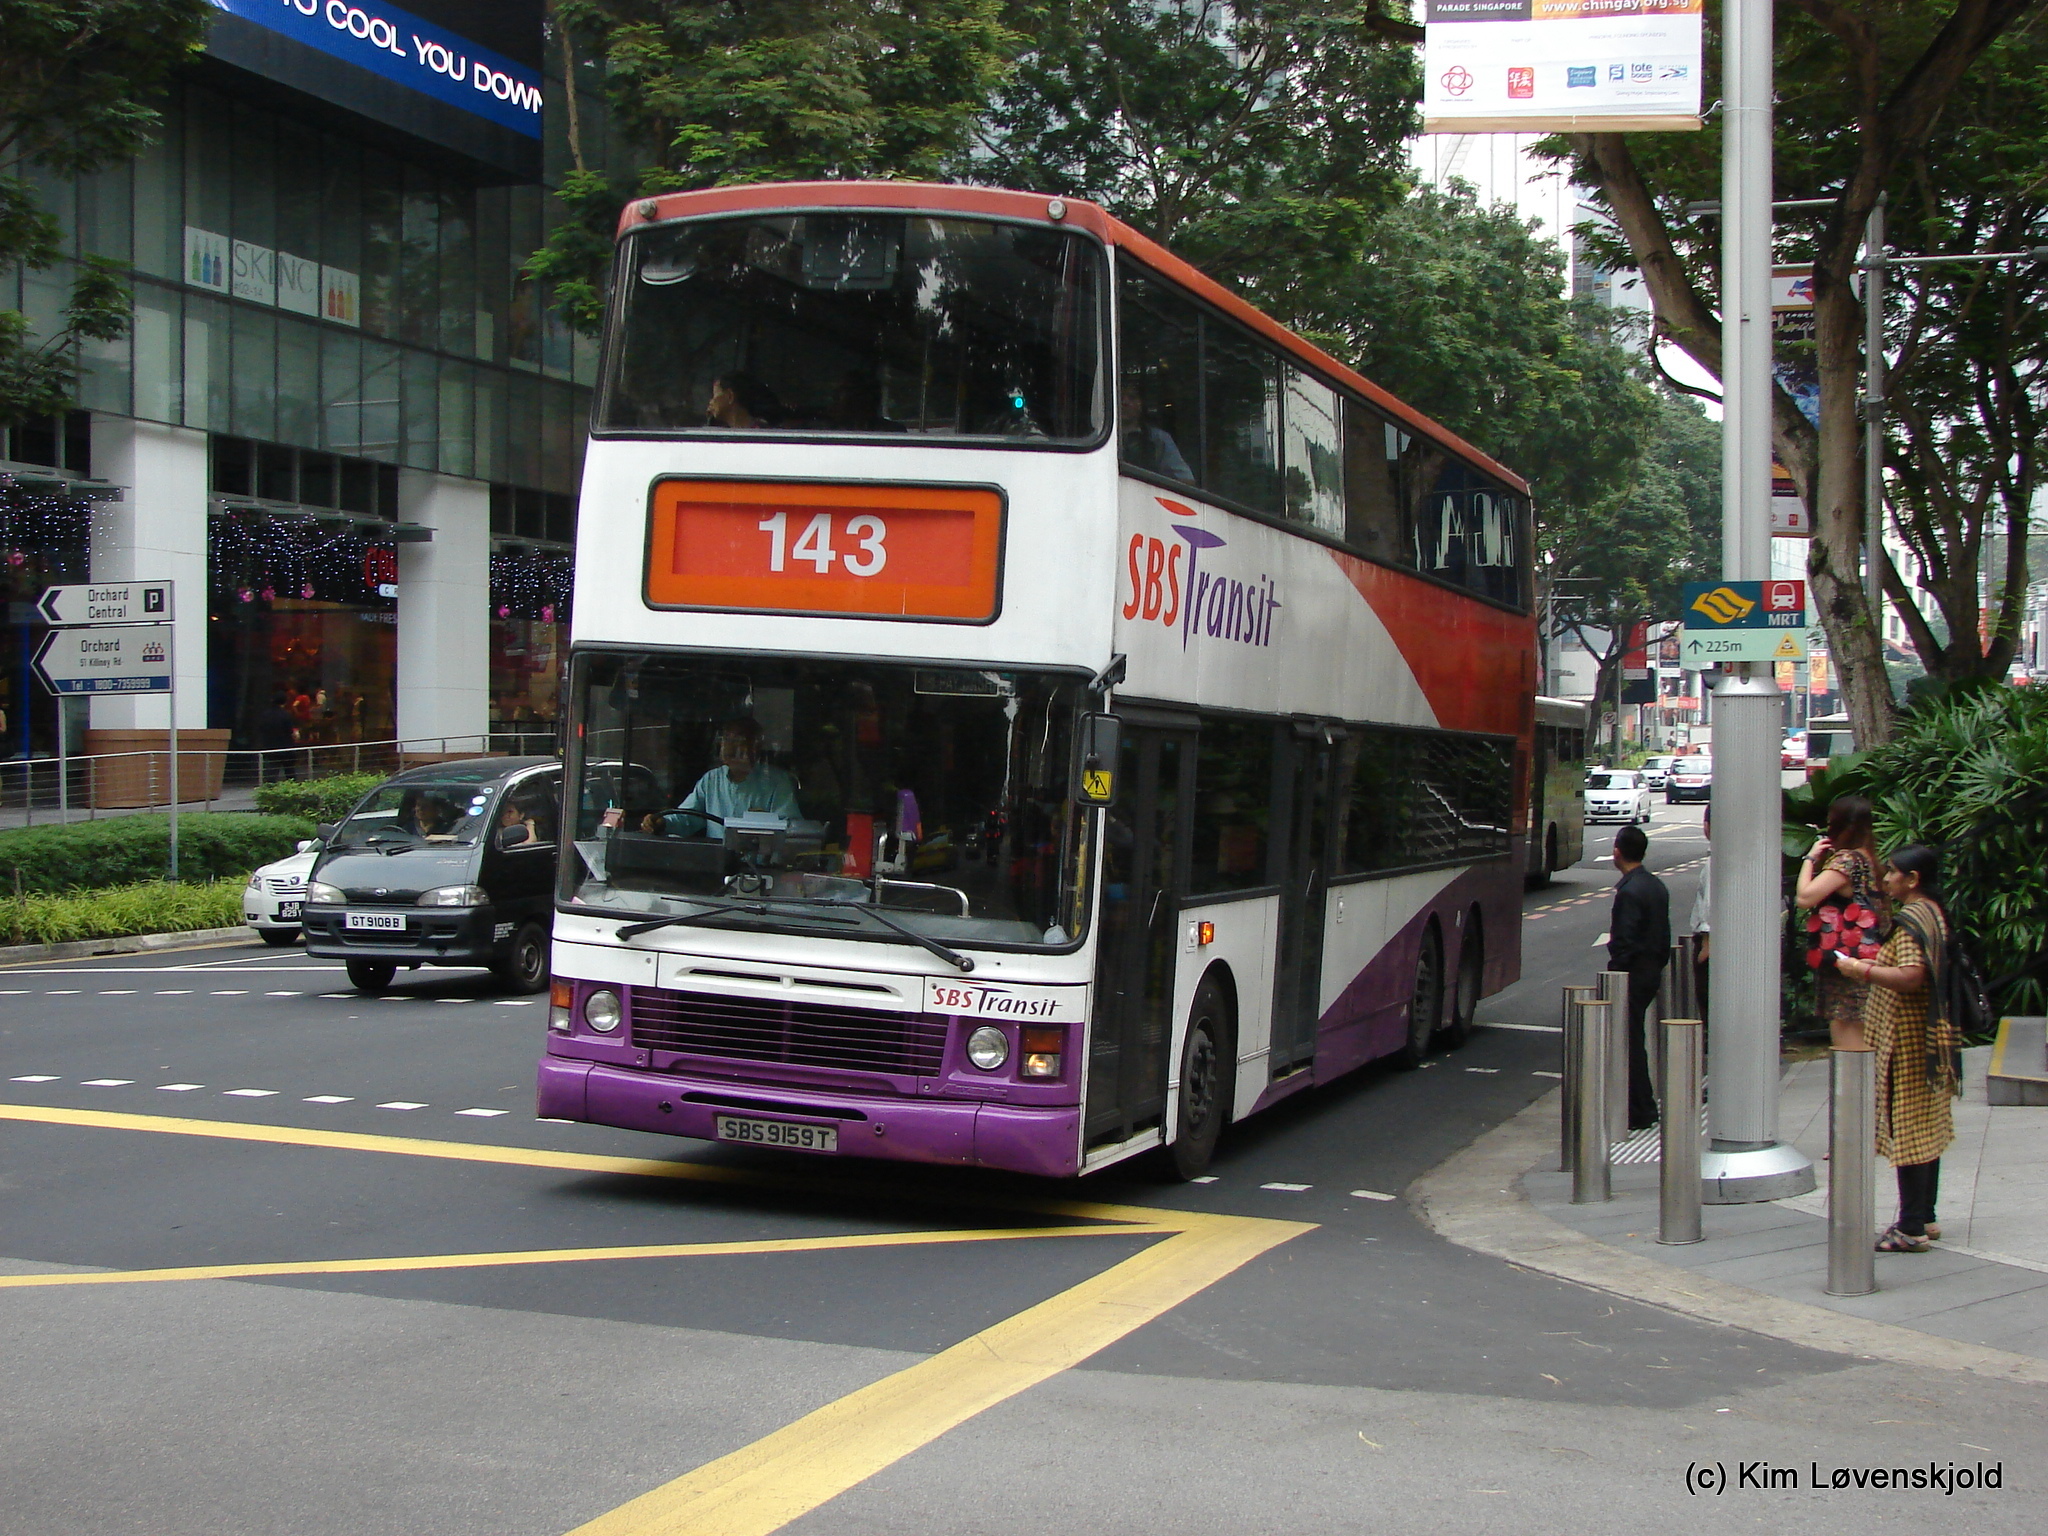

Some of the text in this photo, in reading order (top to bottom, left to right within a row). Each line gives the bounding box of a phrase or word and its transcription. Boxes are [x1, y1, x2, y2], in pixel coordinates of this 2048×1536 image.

[1436, 2, 1523, 12] PARADE SINGAPORE
[325, 0, 407, 57] COOL
[412, 34, 466, 82] YOU
[1631, 62, 1653, 72] tote
[758, 511, 888, 577] 143
[88, 588, 129, 602] Orchard
[1122, 524, 1283, 654] SBS Transit
[149, 592, 160, 609] P
[88, 605, 127, 619] Central
[1768, 613, 1800, 626] MRT
[80, 639, 120, 653] Orchard
[1705, 641, 1742, 653] 225m
[71, 680, 83, 690] Tel
[933, 986, 1064, 1016] SBS Transit
